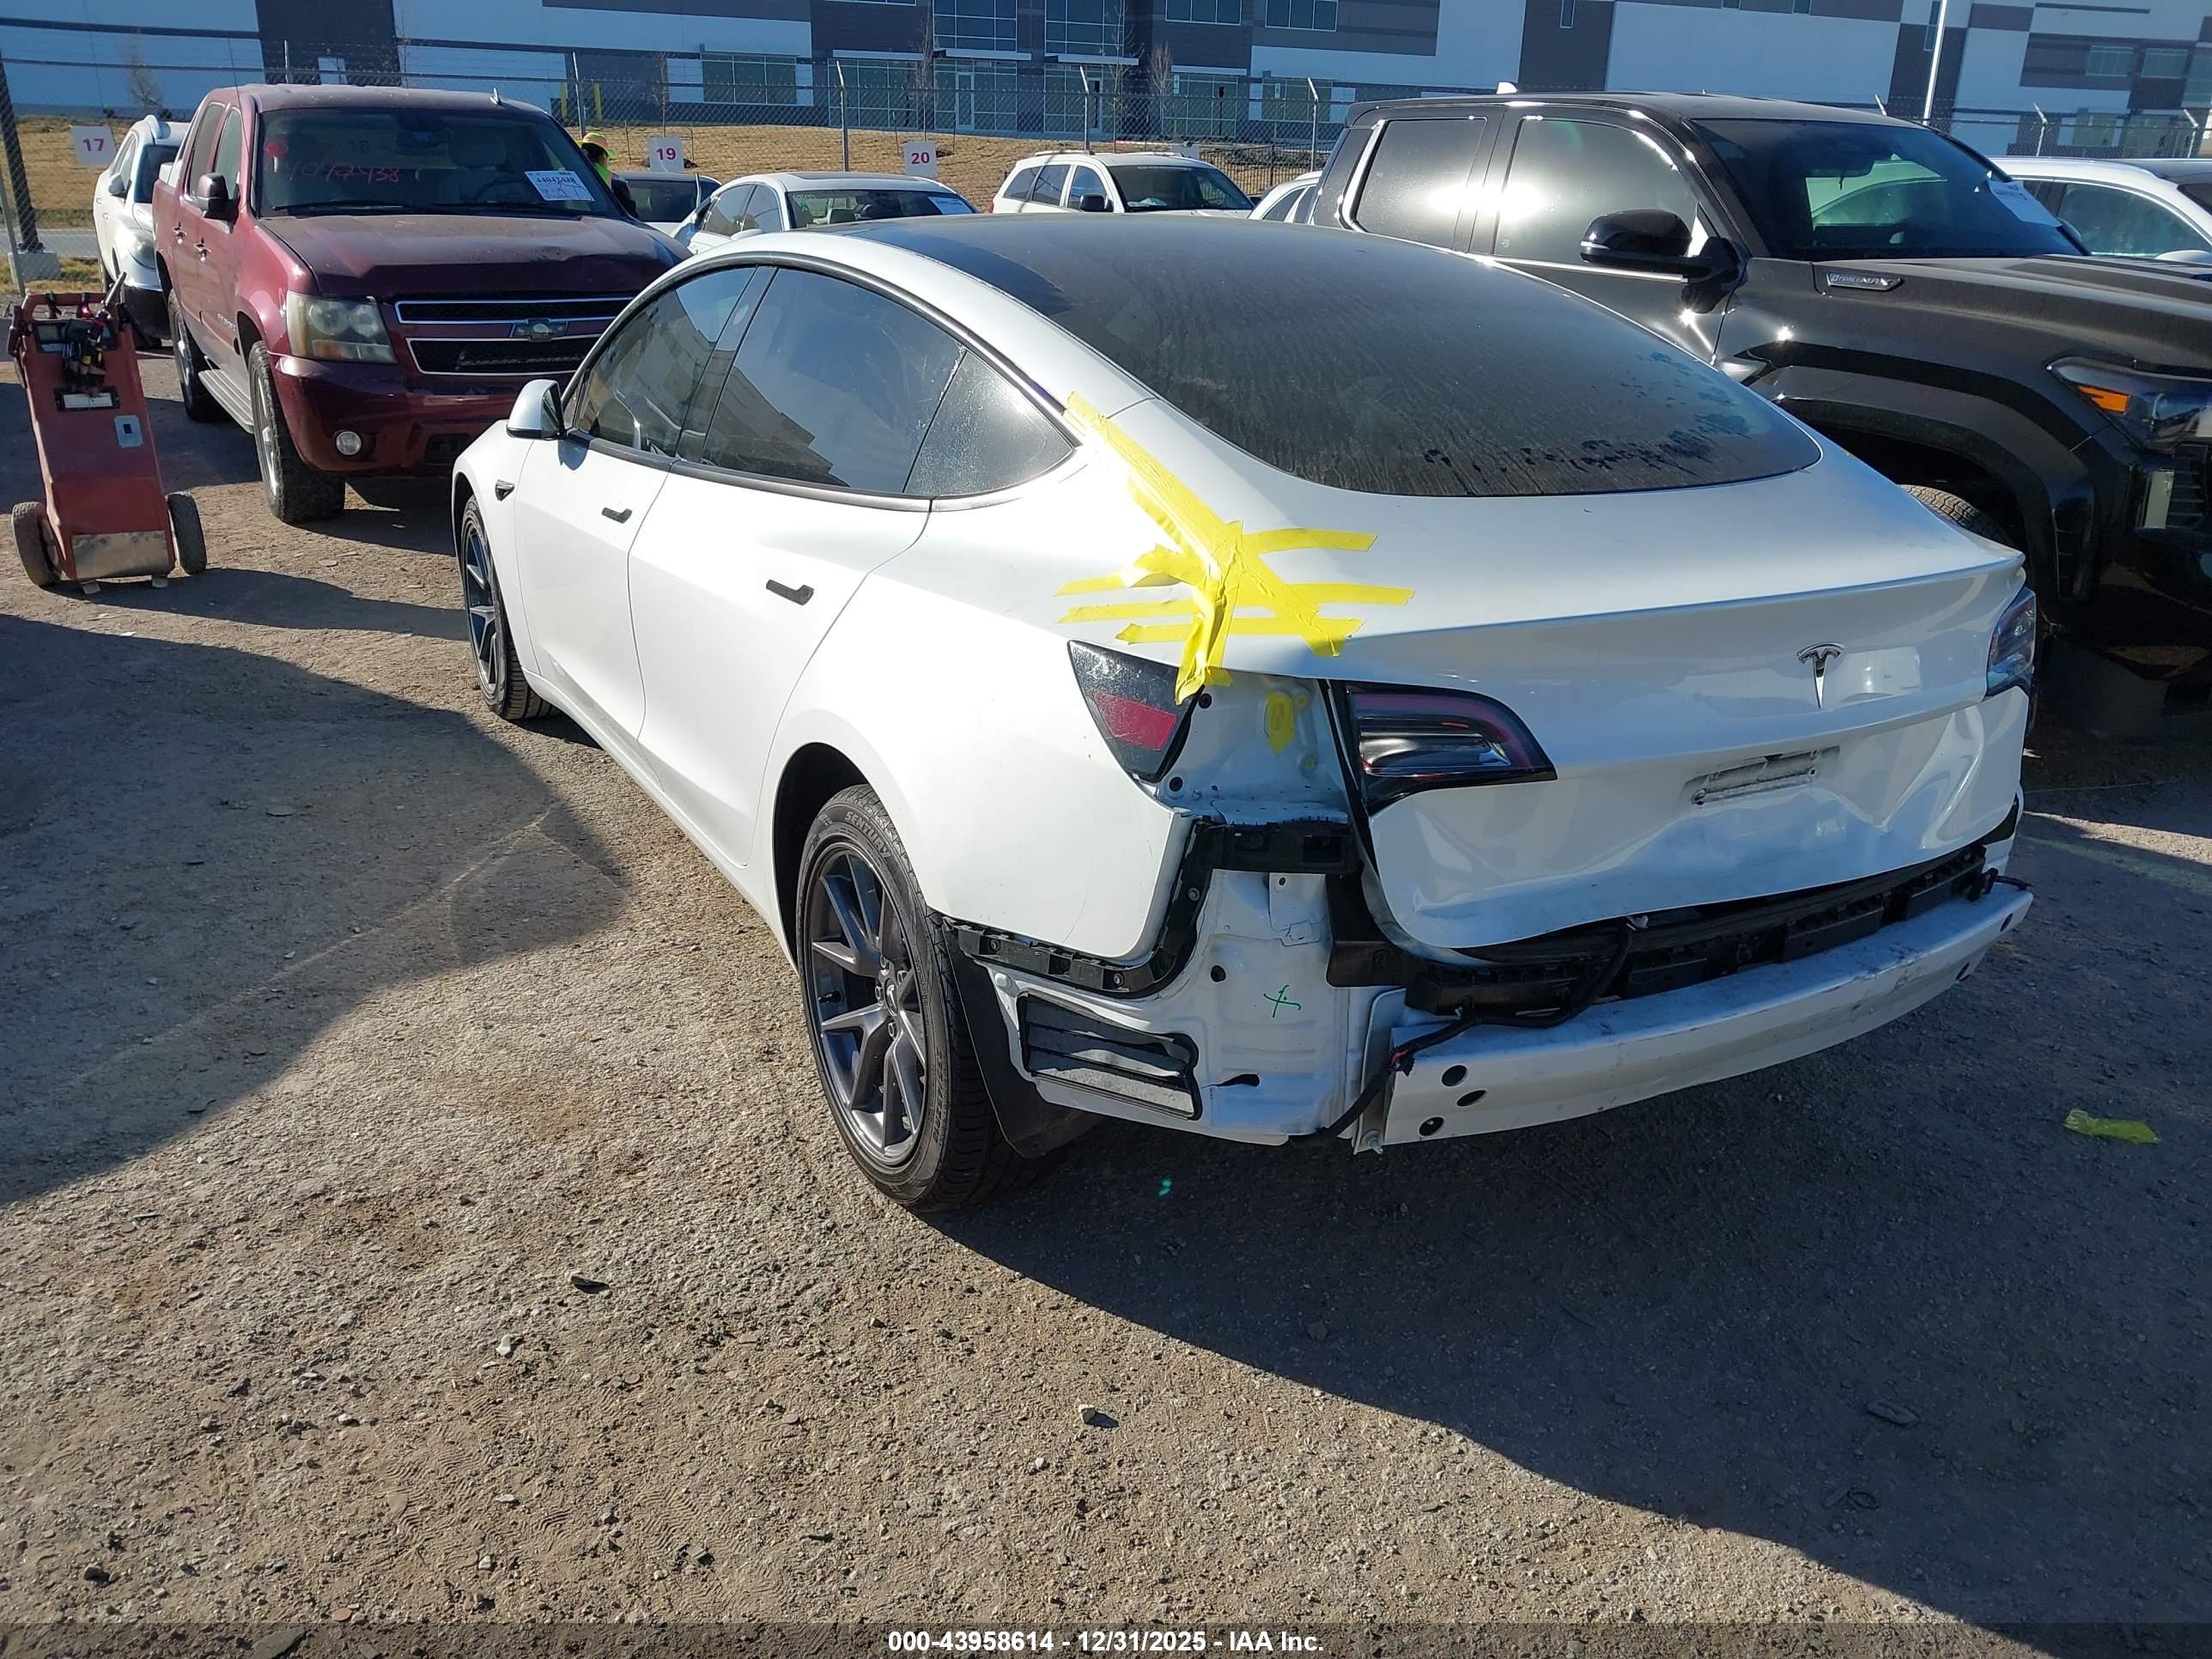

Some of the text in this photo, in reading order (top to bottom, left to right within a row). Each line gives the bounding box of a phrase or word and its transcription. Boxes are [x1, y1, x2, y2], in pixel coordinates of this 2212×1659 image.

[82, 137, 104, 152] 17
[351, 139, 370, 153] 18
[656, 147, 676, 161] 19
[911, 151, 930, 165] 20
[844, 811, 891, 858] SENTURY
